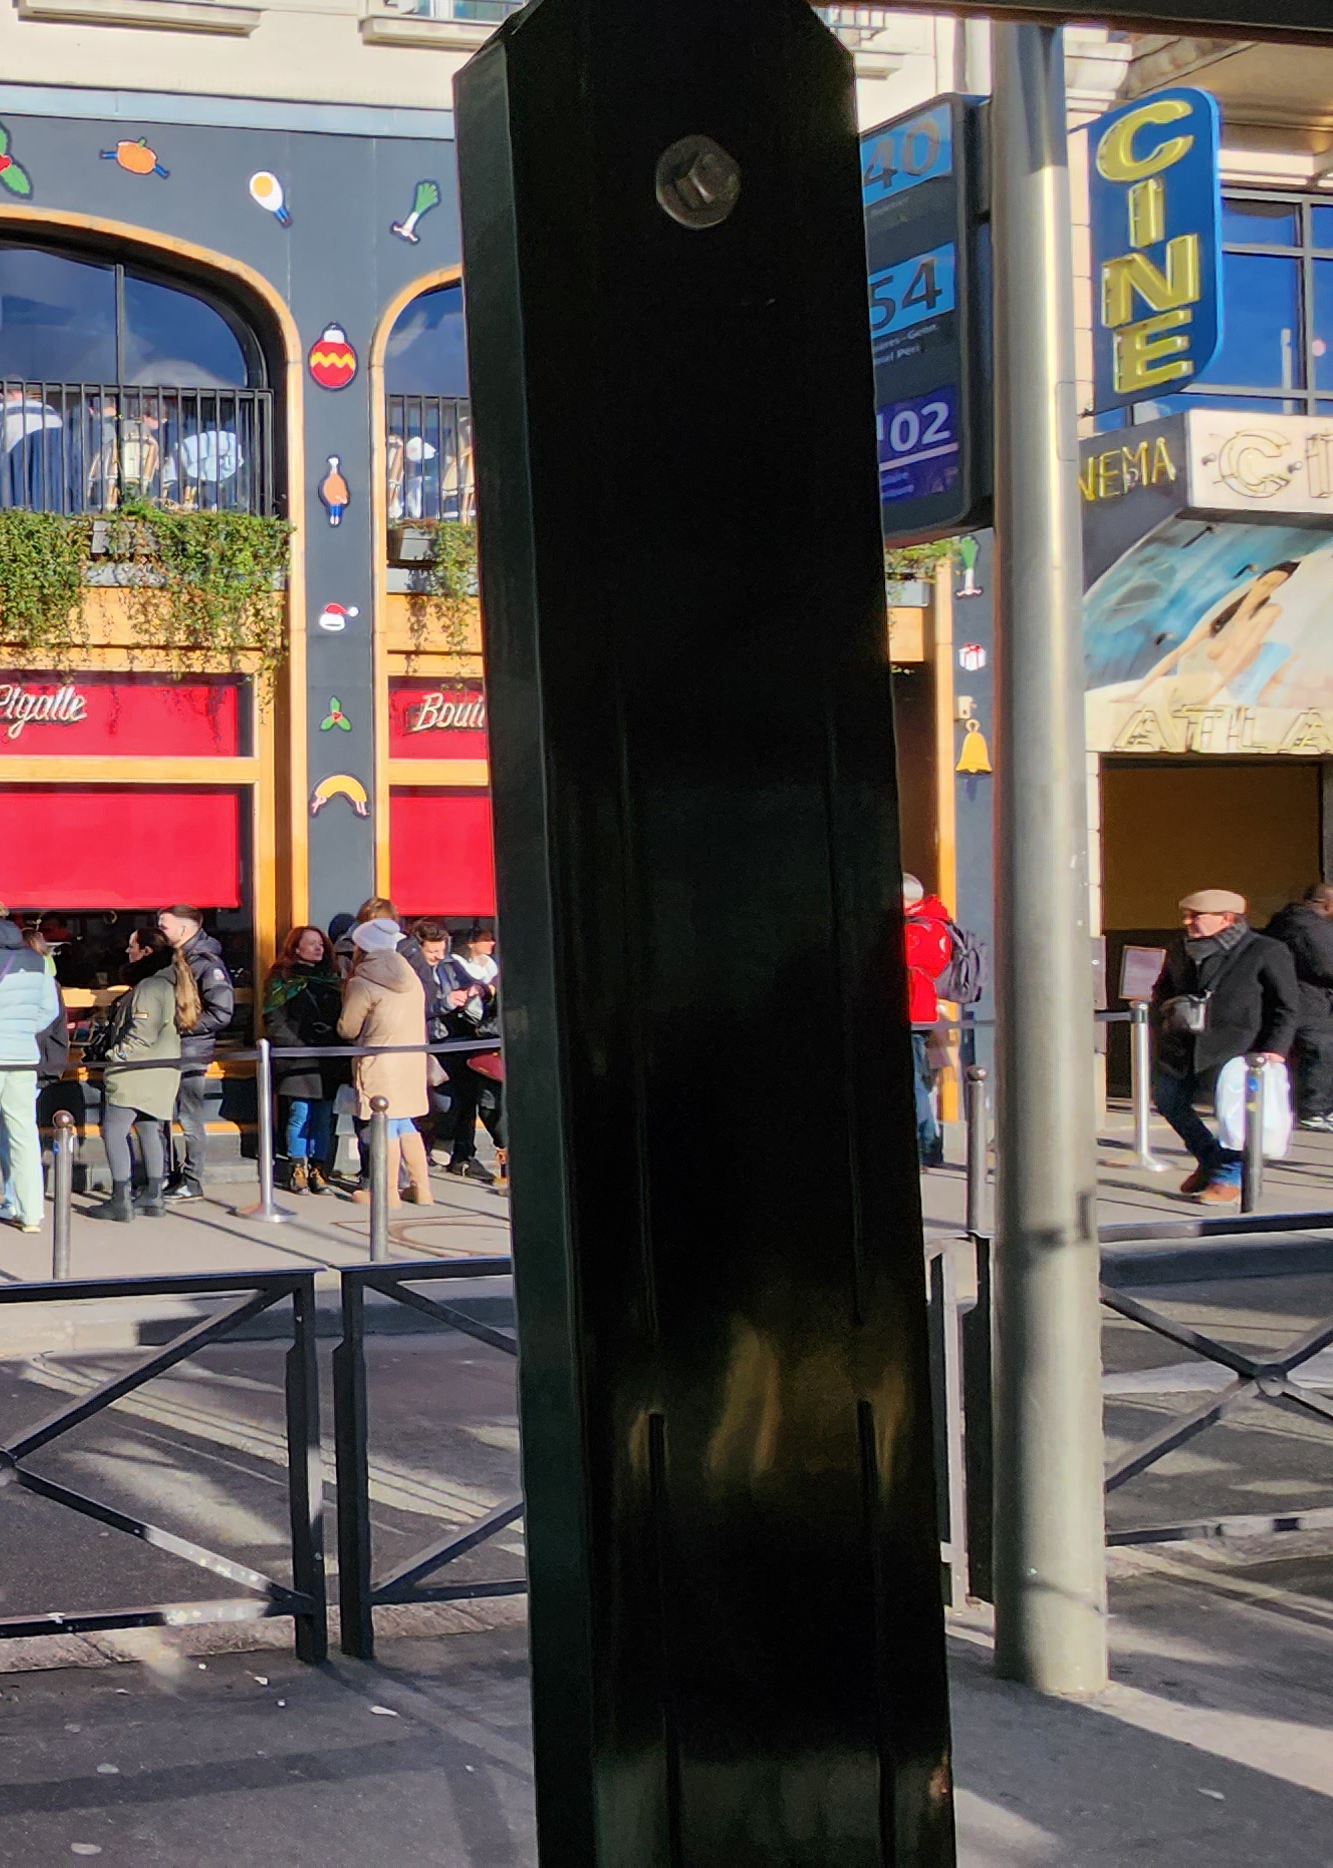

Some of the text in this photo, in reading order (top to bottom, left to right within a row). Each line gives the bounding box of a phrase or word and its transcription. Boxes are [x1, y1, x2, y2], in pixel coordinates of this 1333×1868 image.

[863, 119, 940, 190] 40
[1096, 100, 1201, 393] CINE
[869, 257, 943, 331] 54
